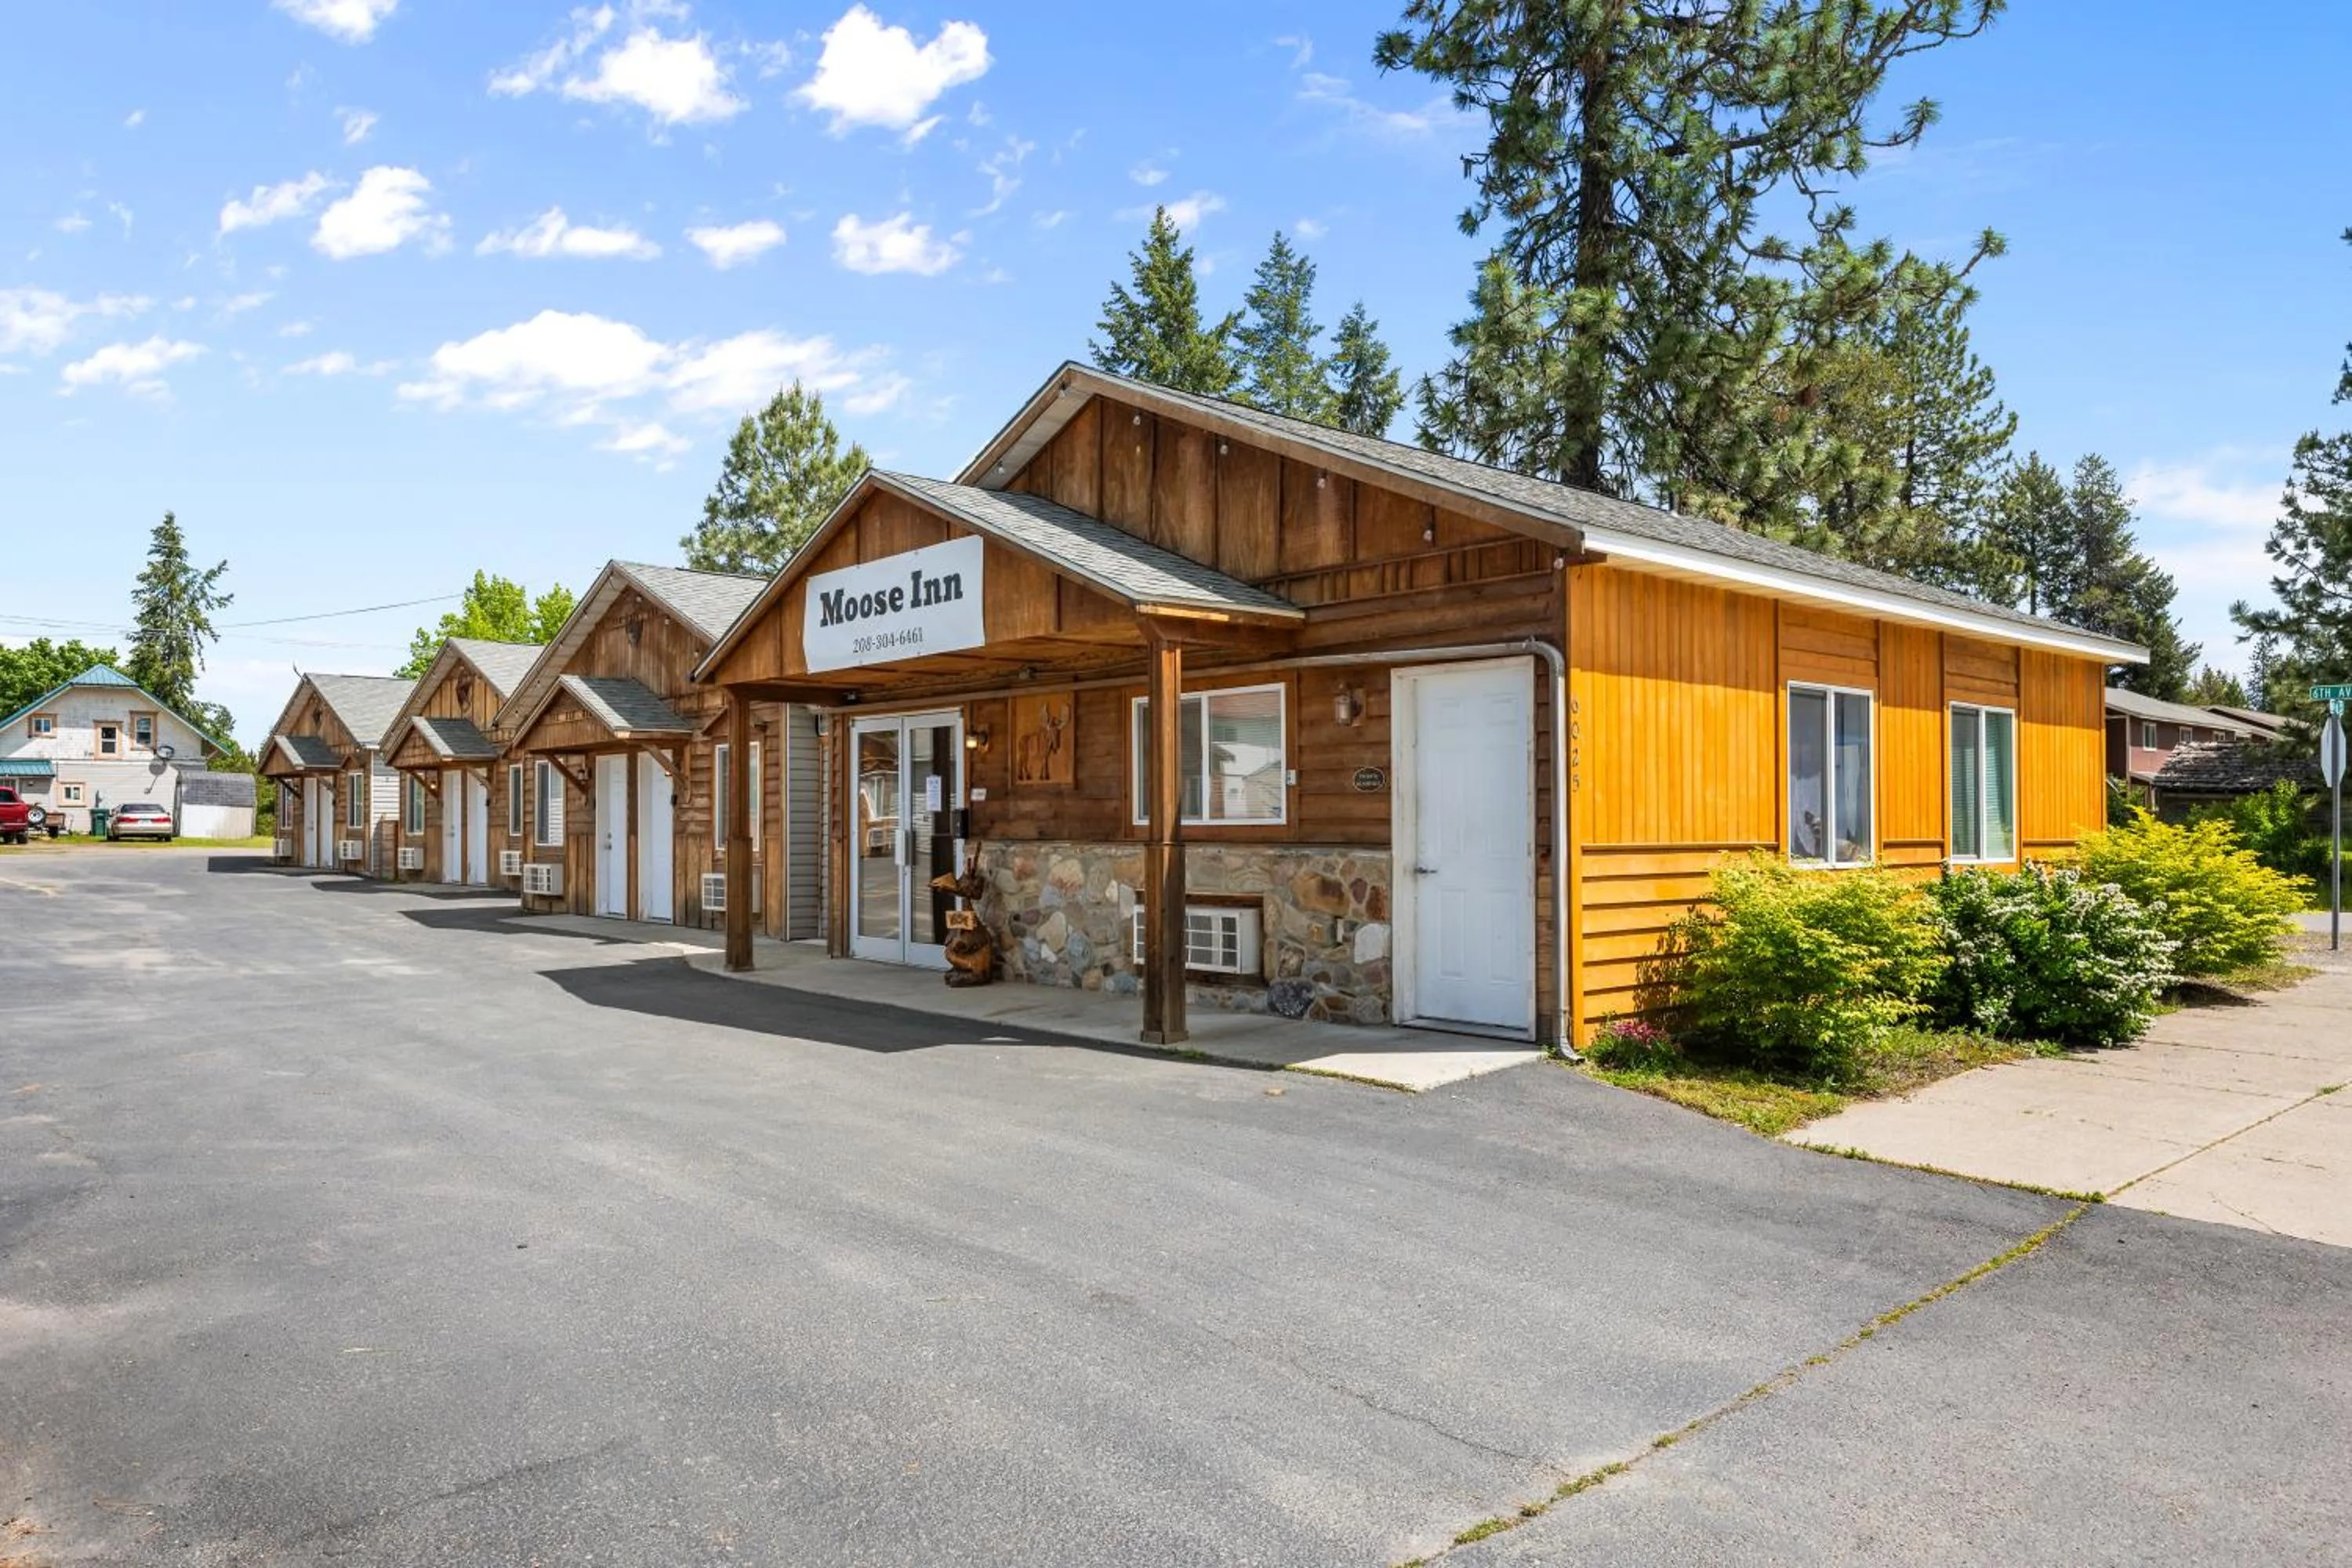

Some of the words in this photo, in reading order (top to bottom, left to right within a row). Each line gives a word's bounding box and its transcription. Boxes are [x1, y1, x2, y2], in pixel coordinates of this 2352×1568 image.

[819, 586, 904, 627] Moose
[910, 570, 964, 609] Inn
[852, 626, 924, 654] 208-304-6461
